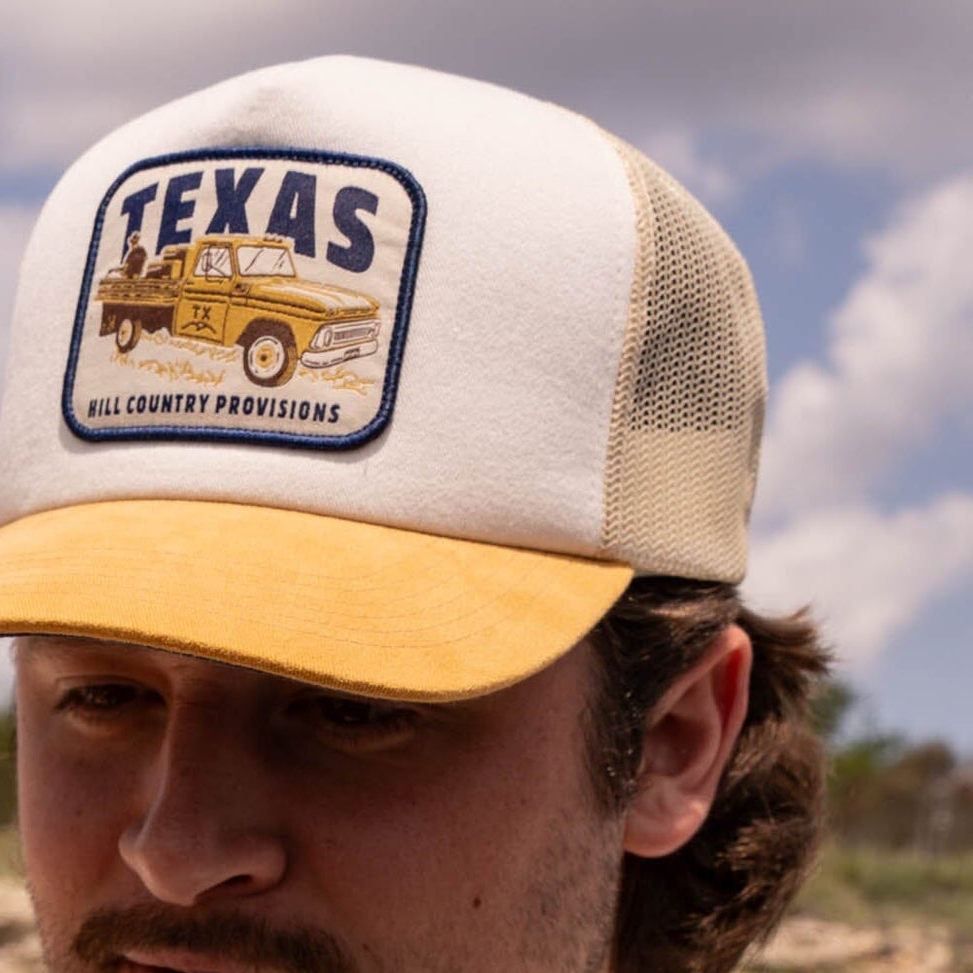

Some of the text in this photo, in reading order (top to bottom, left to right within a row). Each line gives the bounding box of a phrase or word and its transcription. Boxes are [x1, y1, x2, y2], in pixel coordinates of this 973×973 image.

[120, 167, 379, 274] TEXAS
[192, 305, 211, 321] TX
[88, 394, 341, 424] HILL COUNTRY PROVISIONS
